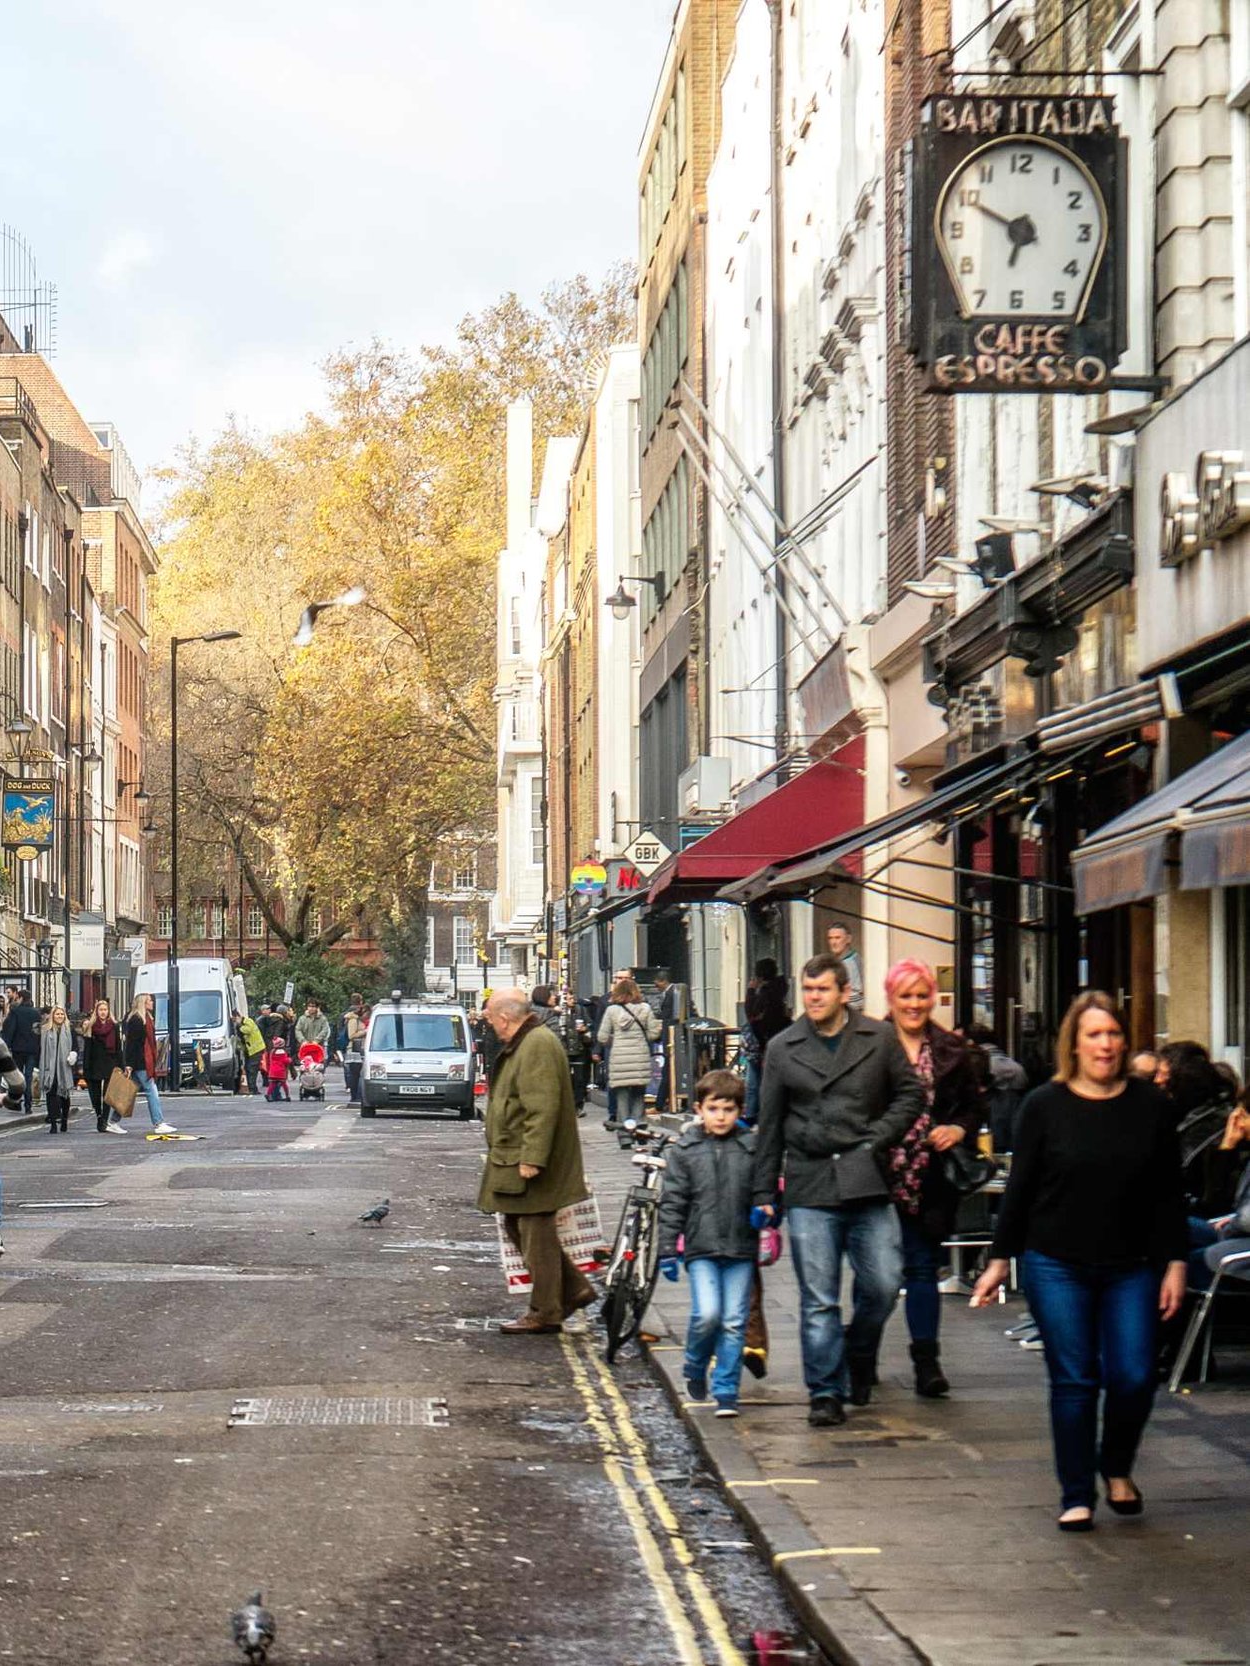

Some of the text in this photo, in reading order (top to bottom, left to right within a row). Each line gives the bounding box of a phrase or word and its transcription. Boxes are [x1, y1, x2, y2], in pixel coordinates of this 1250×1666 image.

[936, 98, 1109, 135] BAR ITALIA
[1010, 153, 1034, 174] 12
[978, 164, 994, 184] 11
[1052, 166, 1060, 185] 1
[959, 188, 981, 207] 10
[1067, 191, 1083, 210] 2
[950, 220, 964, 240] 9
[1077, 223, 1093, 243] 3
[960, 256, 974, 275] 8
[1063, 259, 1080, 279] 4
[972, 289, 987, 309] 7
[1010, 290, 1024, 310] 6
[1052, 291, 1066, 310] 5
[974, 323, 1069, 355] CAFFE
[934, 354, 1107, 386] ESPRESSO
[7, 781, 22, 790] DOG
[31, 782, 51, 790] DUCK
[635, 847, 660, 860] GBK
